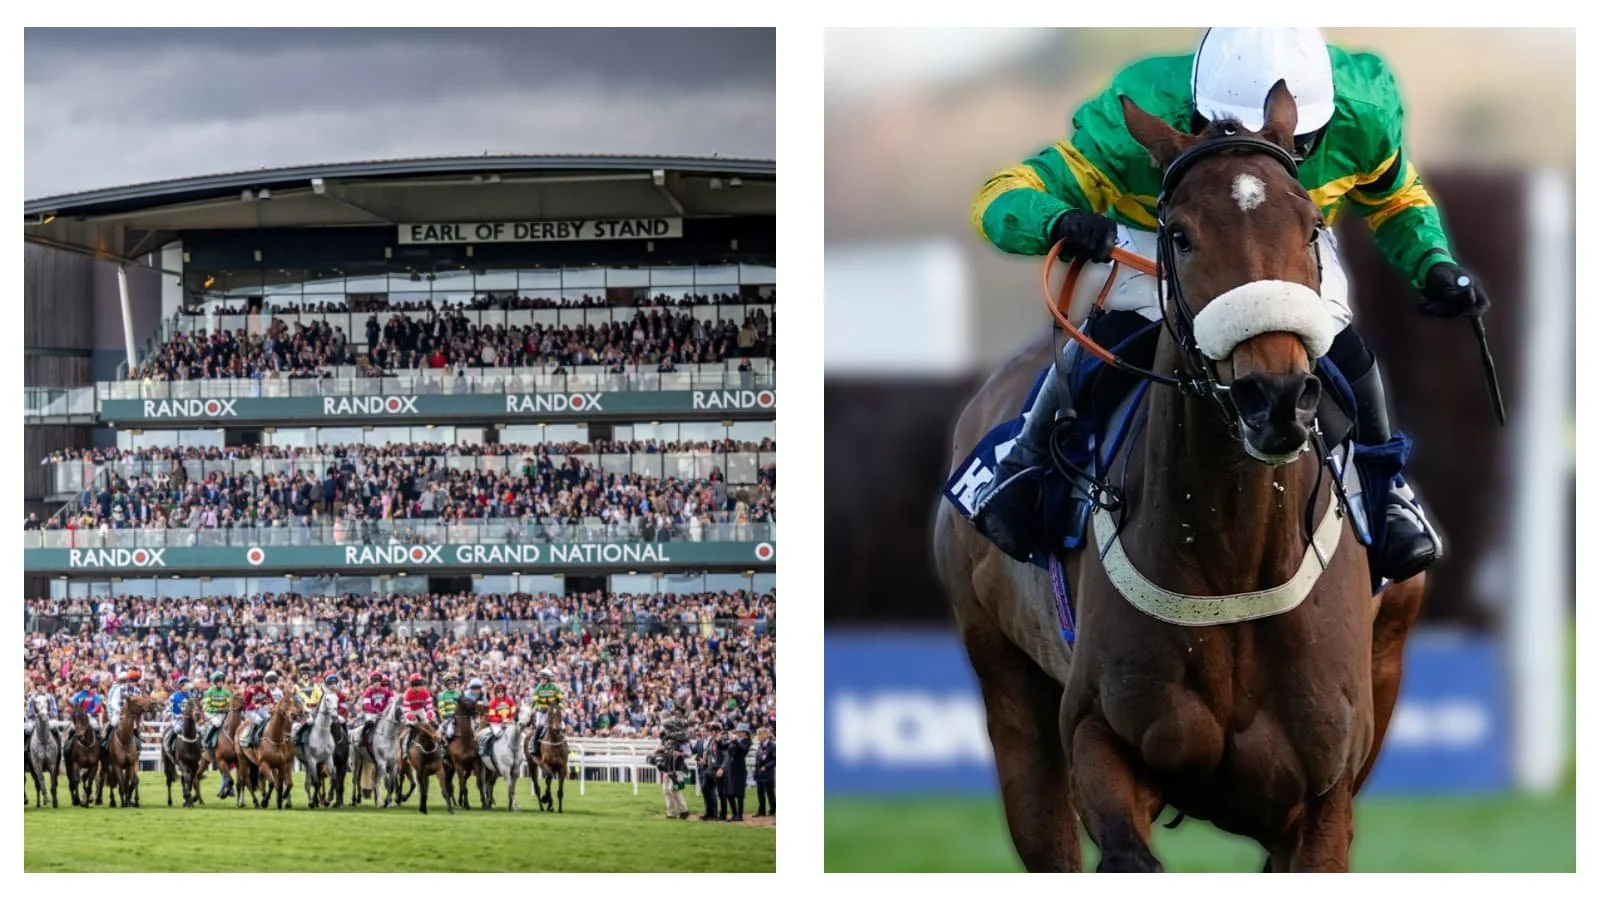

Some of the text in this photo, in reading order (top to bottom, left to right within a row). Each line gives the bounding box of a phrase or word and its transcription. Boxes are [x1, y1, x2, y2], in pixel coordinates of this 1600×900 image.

[411, 219, 669, 241] EARL OF DERBY STAND
[143, 398, 237, 418] RANDOX
[323, 396, 418, 415] RANDOX
[506, 393, 602, 413] RANDOX
[692, 389, 776, 409] RANDO
[69, 547, 166, 567] RANDOX
[345, 543, 670, 565] RANDOX GRAND NATIONAL
